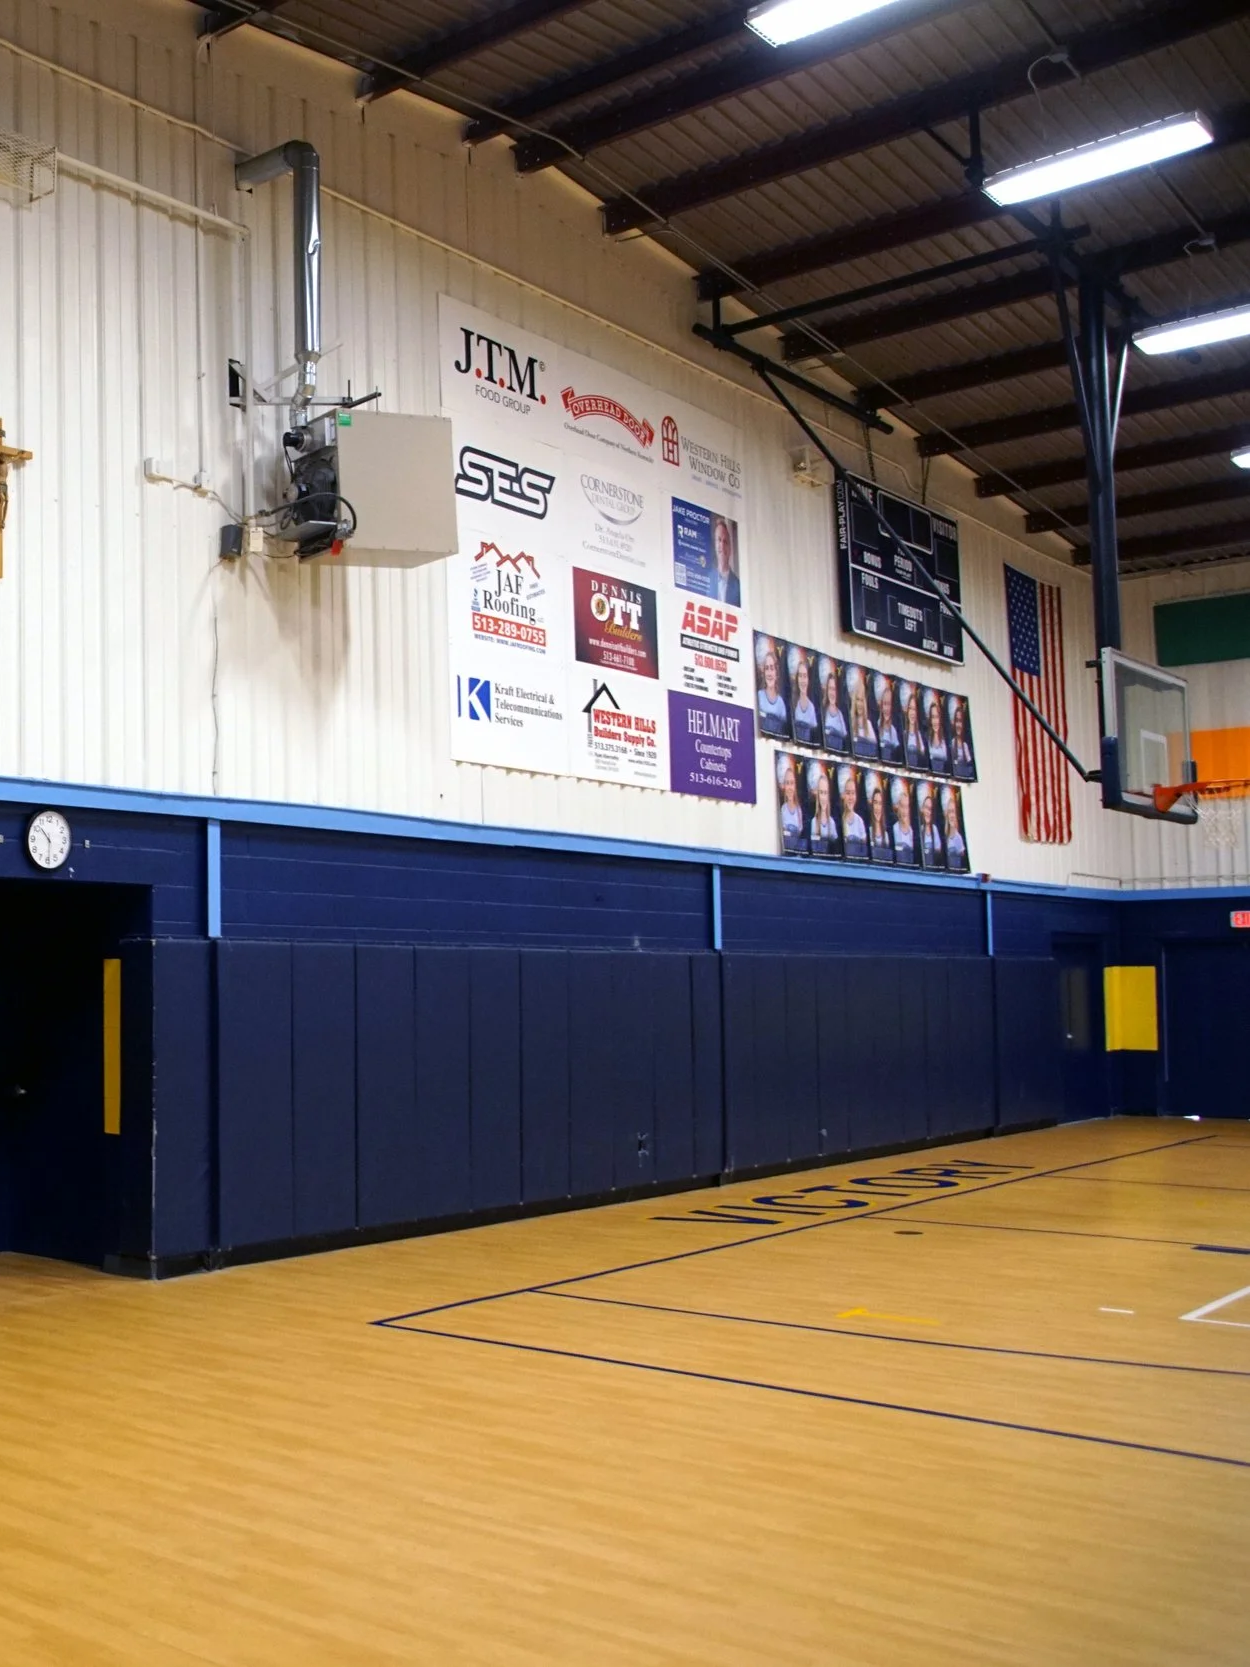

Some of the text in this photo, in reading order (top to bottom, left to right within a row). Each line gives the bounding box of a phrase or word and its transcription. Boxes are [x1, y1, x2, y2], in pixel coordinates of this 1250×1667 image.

[475, 384, 531, 414] FOOD GROUP
[573, 399, 647, 440] OVERHEAD DOOR
[681, 436, 742, 474] WESTERN HILLS
[455, 446, 555, 520] SES
[689, 456, 726, 482] WINDOW
[729, 473, 741, 489] CO
[580, 474, 644, 509] CORNERSTONE
[672, 505, 685, 516] JAKE
[686, 509, 710, 524] PROCTOR
[494, 569, 524, 597] JAF
[591, 580, 642, 604] DENNIS
[482, 589, 536, 625] Roofing
[591, 593, 642, 631] OTT
[681, 601, 738, 642] ASAP
[473, 615, 545, 645] 513-289-0755
[604, 620, 643, 641] Builders
[494, 683, 555, 704] Kraft Electrical &
[494, 698, 563, 720] Telecommunications
[494, 713, 524, 727] Services
[593, 708, 656, 734] WESTERN HILLS
[593, 725, 622, 741] Builders
[624, 731, 645, 747] Supply
[646, 735, 656, 747] Co.
[687, 708, 740, 742] HELMART
[695, 739, 732, 761] Countertops
[700, 757, 727, 773] Cabinets
[689, 772, 742, 789] 513-616-2420
[646, 1158, 1035, 1226] VICTORY
